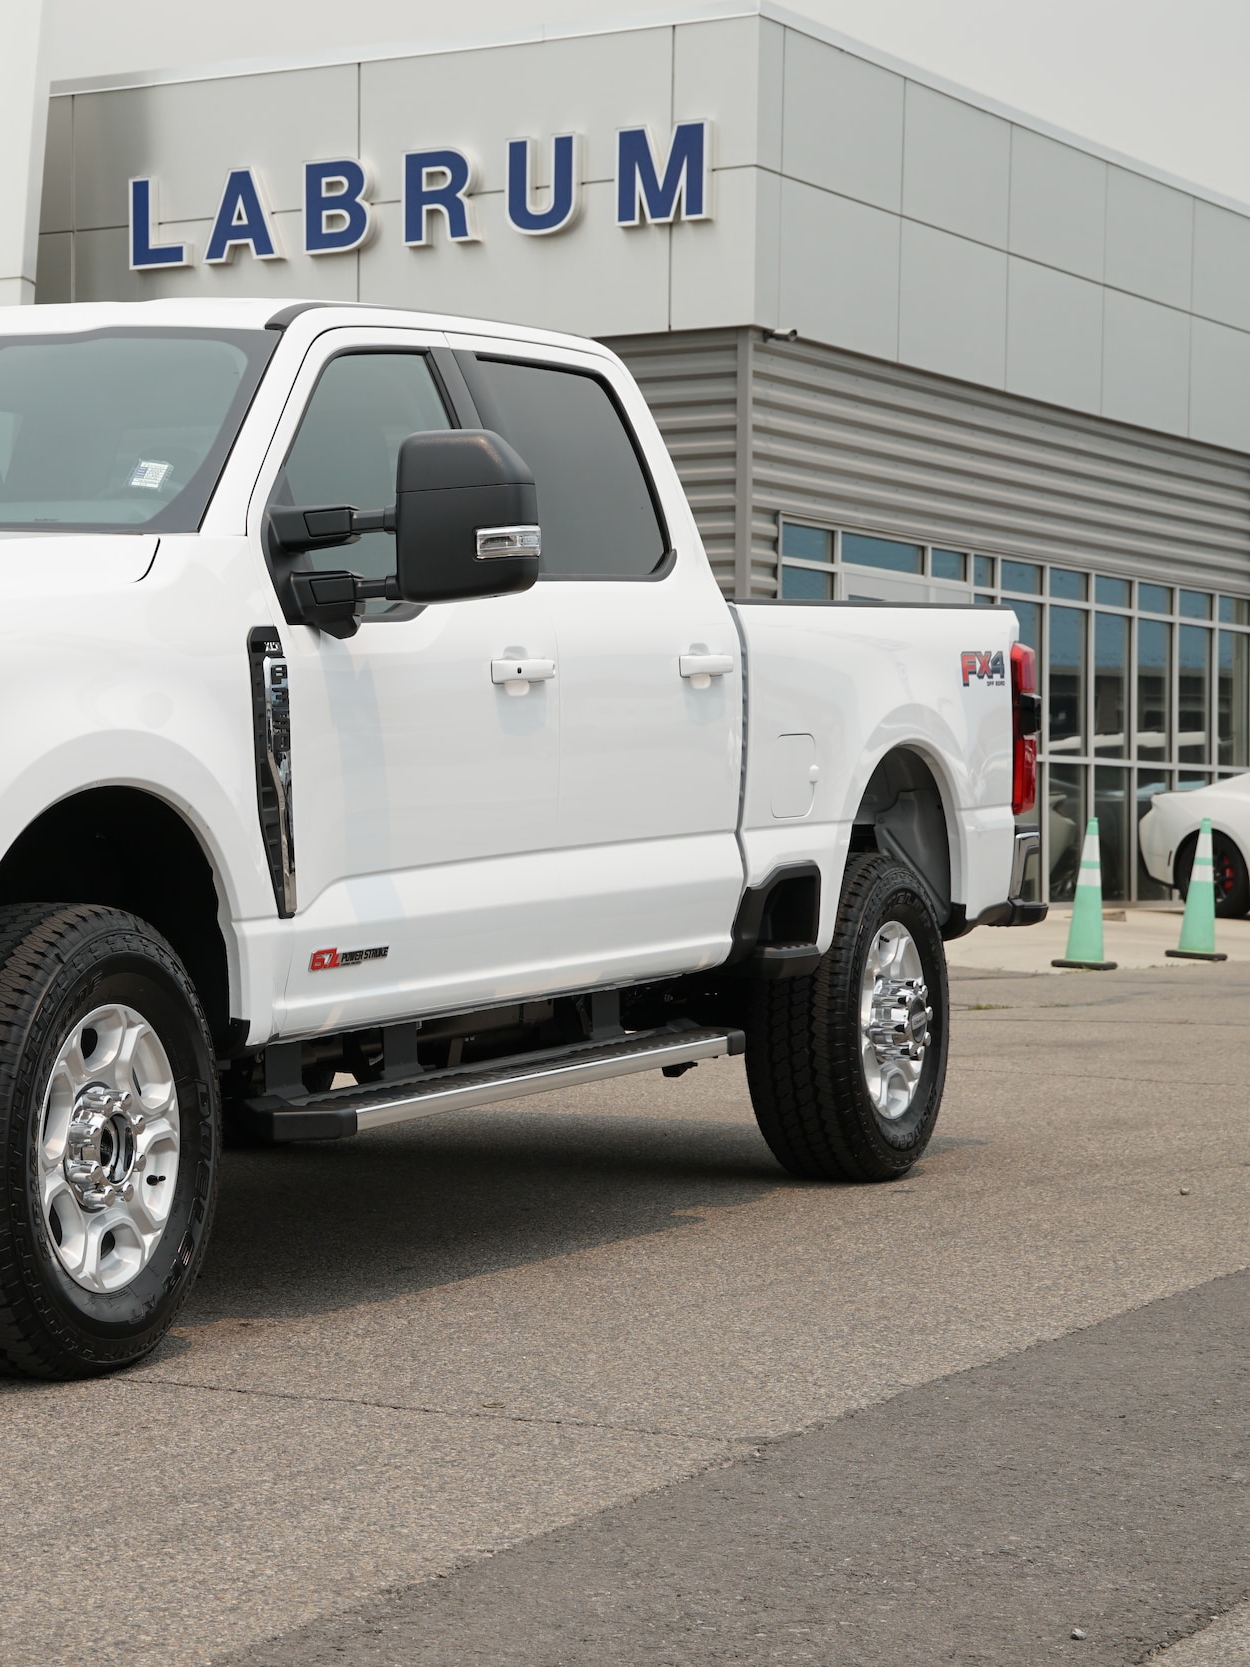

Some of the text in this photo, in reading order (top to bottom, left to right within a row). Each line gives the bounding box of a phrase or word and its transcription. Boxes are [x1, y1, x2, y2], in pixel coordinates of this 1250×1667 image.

[129, 118, 713, 271] LABRUM
[961, 651, 1005, 687] FX4
[341, 950, 363, 962] POWER
[364, 946, 389, 959] STROKE
[163, 1079, 212, 1294] DUELER
